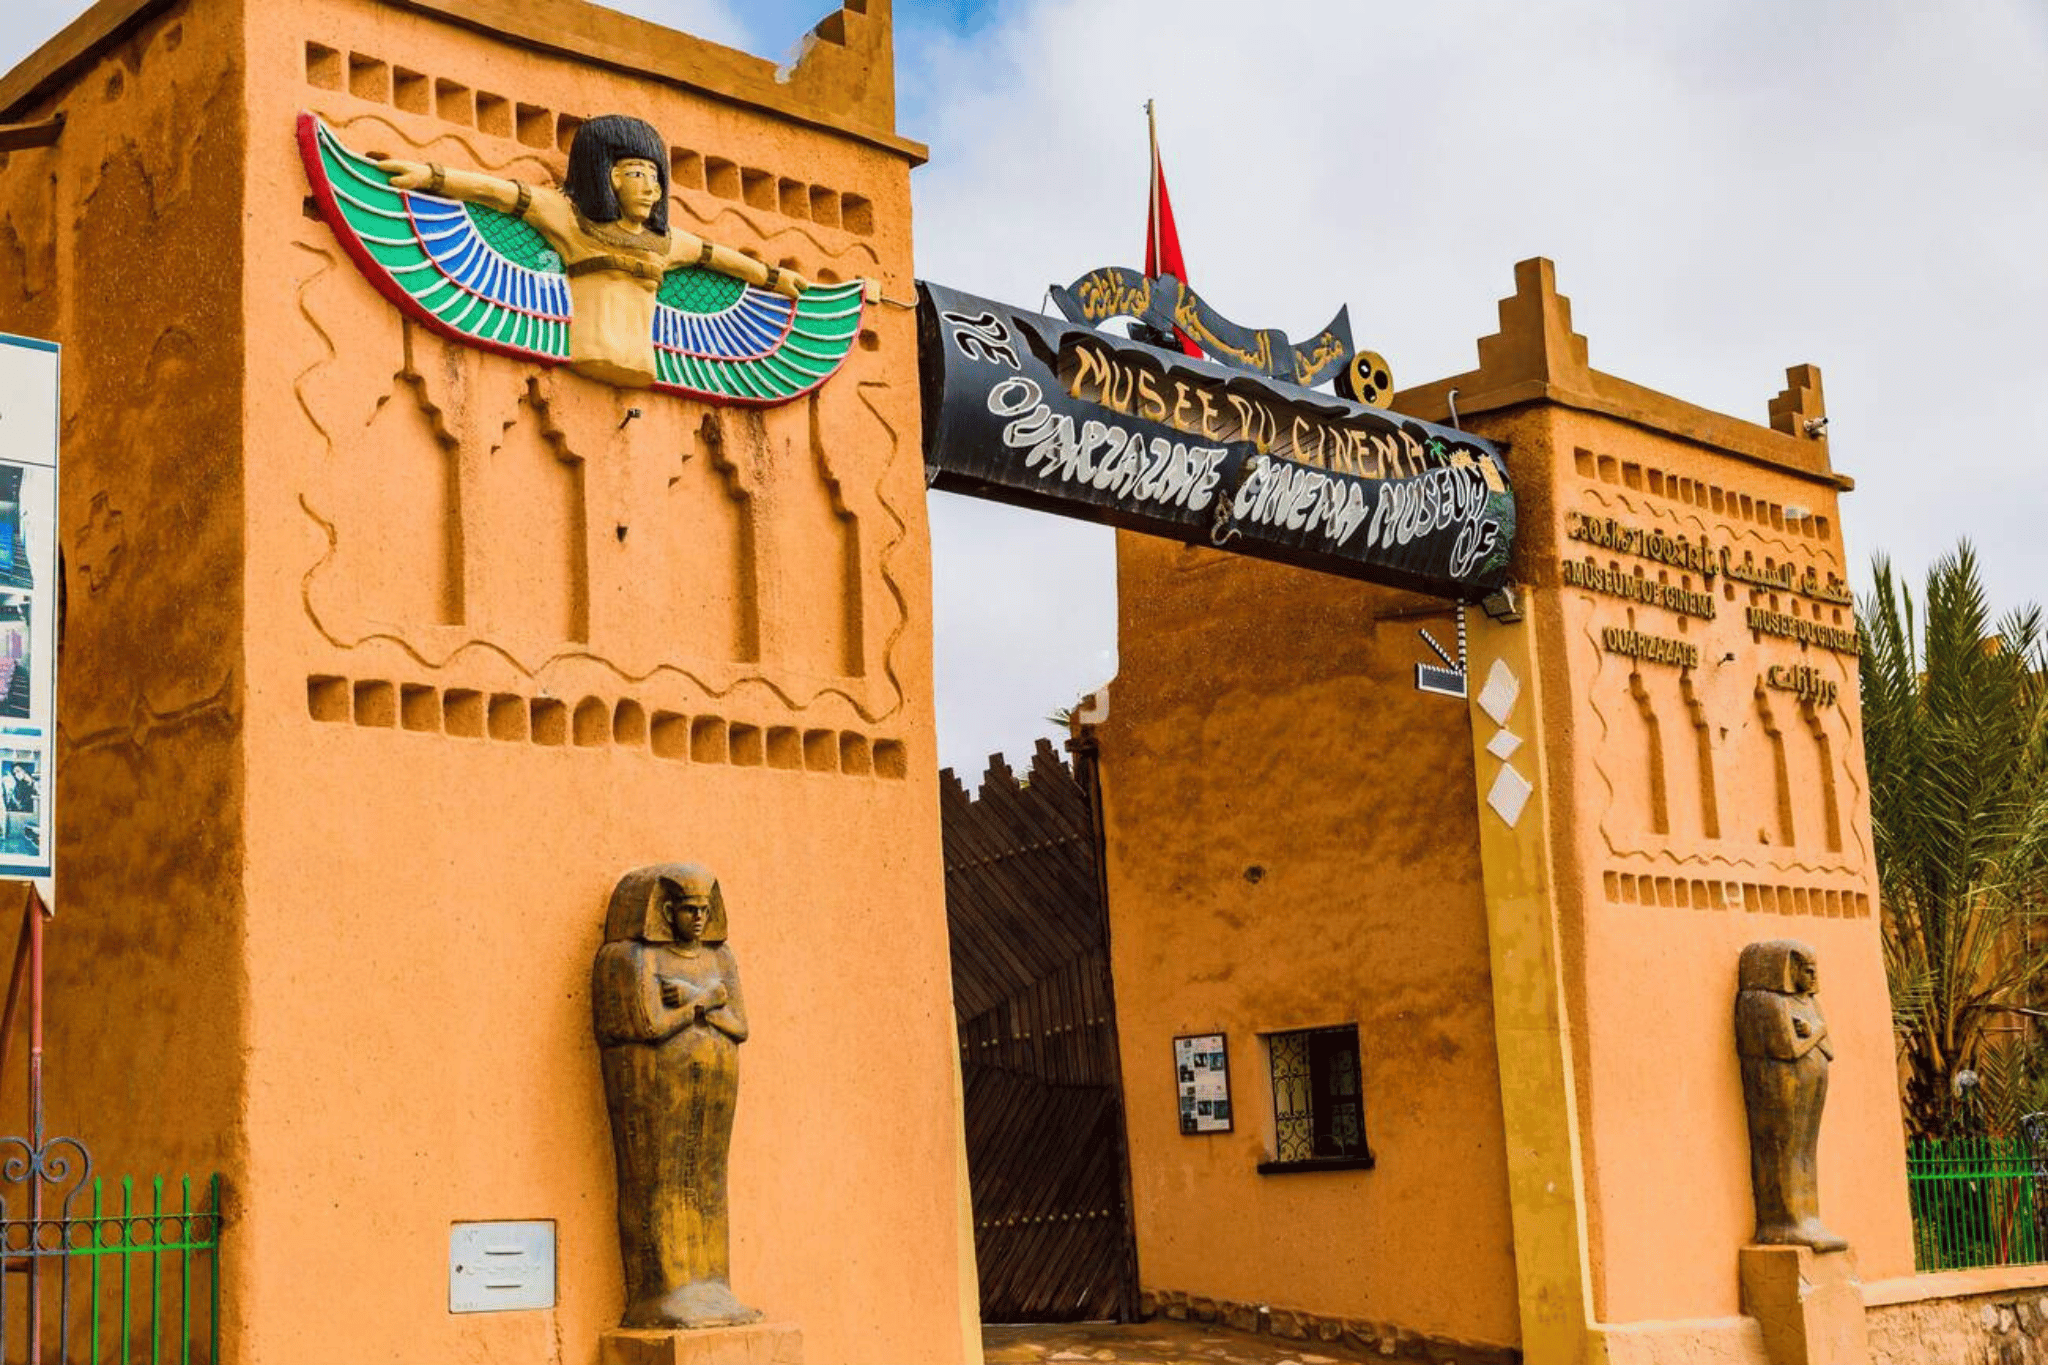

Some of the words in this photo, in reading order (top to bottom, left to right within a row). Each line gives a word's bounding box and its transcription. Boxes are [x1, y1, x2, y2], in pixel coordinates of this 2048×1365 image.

[987, 376, 1228, 511] OUARZAZATE
[1070, 344, 1220, 442] MUSEE
[1227, 393, 1277, 455] DU
[1292, 415, 1428, 479] CINEMA
[1233, 453, 1370, 547] CINEMA
[1366, 464, 1490, 549] MUSEUM
[1449, 516, 1499, 578] OF
[1567, 560, 1639, 600] MUSEUM
[1664, 585, 1716, 620] CINEMA
[1747, 607, 1798, 637] MUSEE
[1798, 619, 1817, 644] DU
